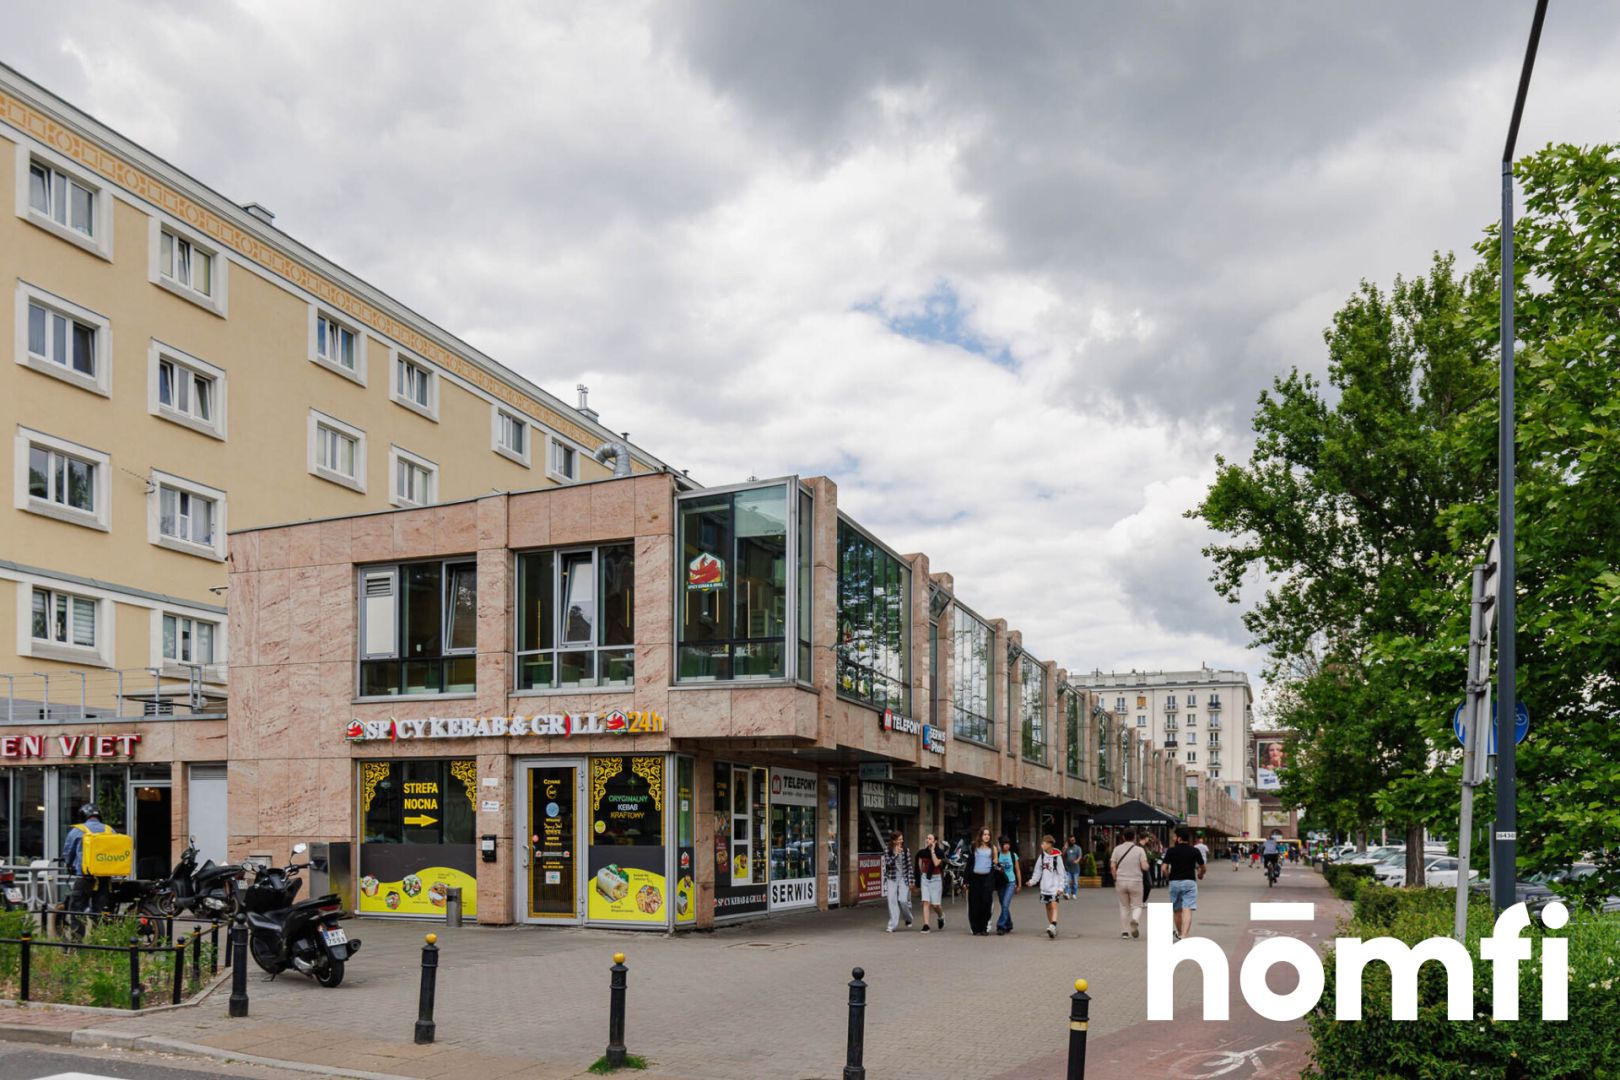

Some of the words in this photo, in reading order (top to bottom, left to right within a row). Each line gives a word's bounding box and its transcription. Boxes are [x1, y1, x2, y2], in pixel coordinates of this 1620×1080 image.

[430, 717, 507, 738] KEBAB
[627, 710, 664, 733] 24h
[893, 715, 920, 735] TELEFONY
[1, 736, 42, 757] EN
[58, 734, 141, 758] VIET
[403, 782, 438, 794] STREFA
[783, 775, 817, 791] TELEFONY
[404, 798, 438, 810] NOCNA
[608, 795, 648, 803] ORYGINALNY
[96, 852, 126, 862] Glovo
[772, 882, 814, 903] SERWIS
